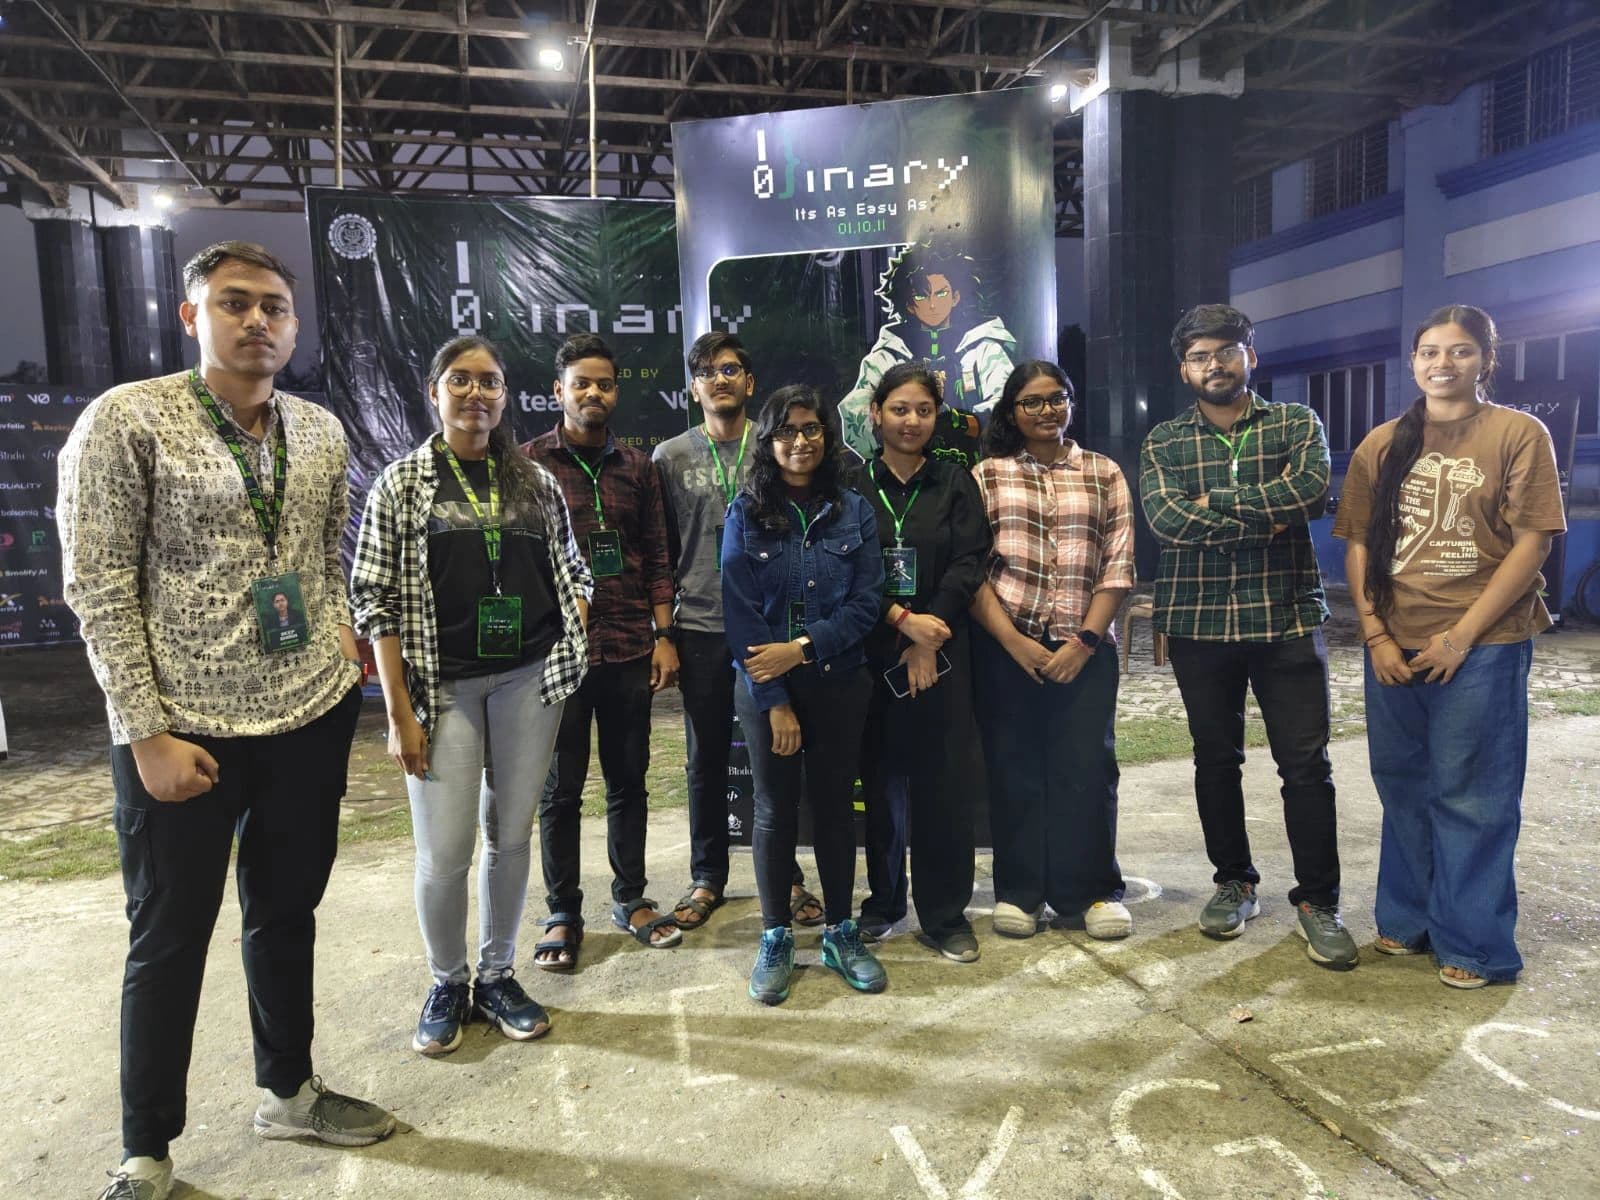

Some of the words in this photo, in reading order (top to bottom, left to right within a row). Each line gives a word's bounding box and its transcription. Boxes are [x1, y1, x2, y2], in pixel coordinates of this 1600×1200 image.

[795, 208, 817, 221] Its
[827, 206, 846, 218] As
[856, 203, 897, 216] Easy
[907, 199, 928, 211] As
[641, 368, 659, 379] BY
